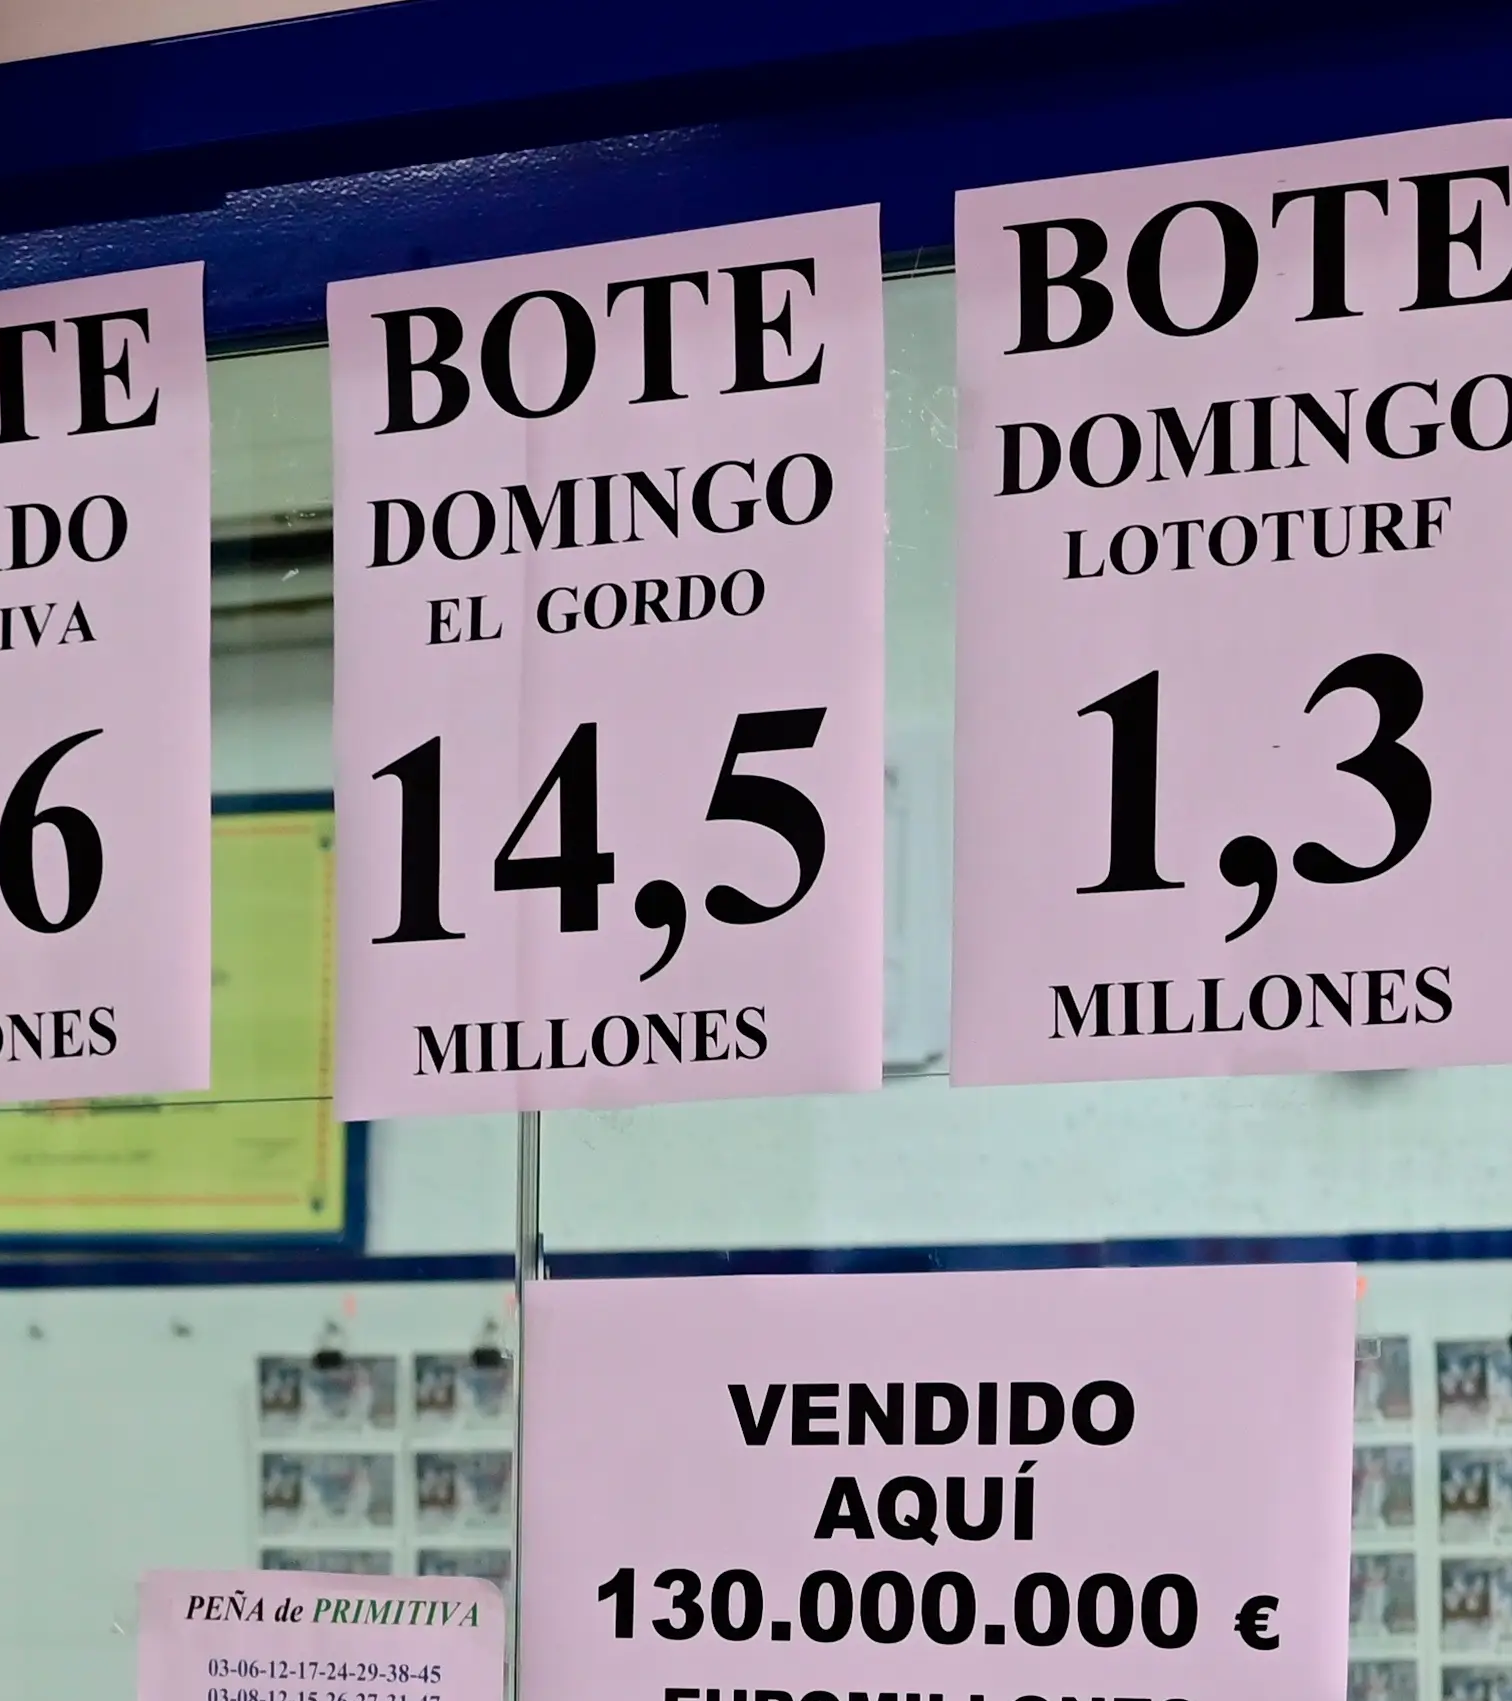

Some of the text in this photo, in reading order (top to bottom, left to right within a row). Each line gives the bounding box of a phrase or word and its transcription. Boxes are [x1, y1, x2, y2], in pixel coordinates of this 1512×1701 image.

[371, 256, 826, 436] BOTE
[366, 452, 834, 569] DOMINGO
[1063, 497, 1452, 580] LOTOTURF
[426, 569, 765, 646] EL GORDO
[1076, 652, 1432, 942] 1,3
[371, 706, 828, 981] 14,5
[413, 1005, 768, 1076] MILLONES
[1049, 965, 1453, 1039] MILLONES
[728, 1380, 1135, 1446] VENDIDO
[815, 1461, 1035, 1545] AQUÍ
[185, 1589, 480, 1627] PEÑA de PRIMITIVA
[597, 1567, 1280, 1650] 130.000.000 €
[208, 1658, 441, 1684] 03-06-12-17-24-29-38-45
